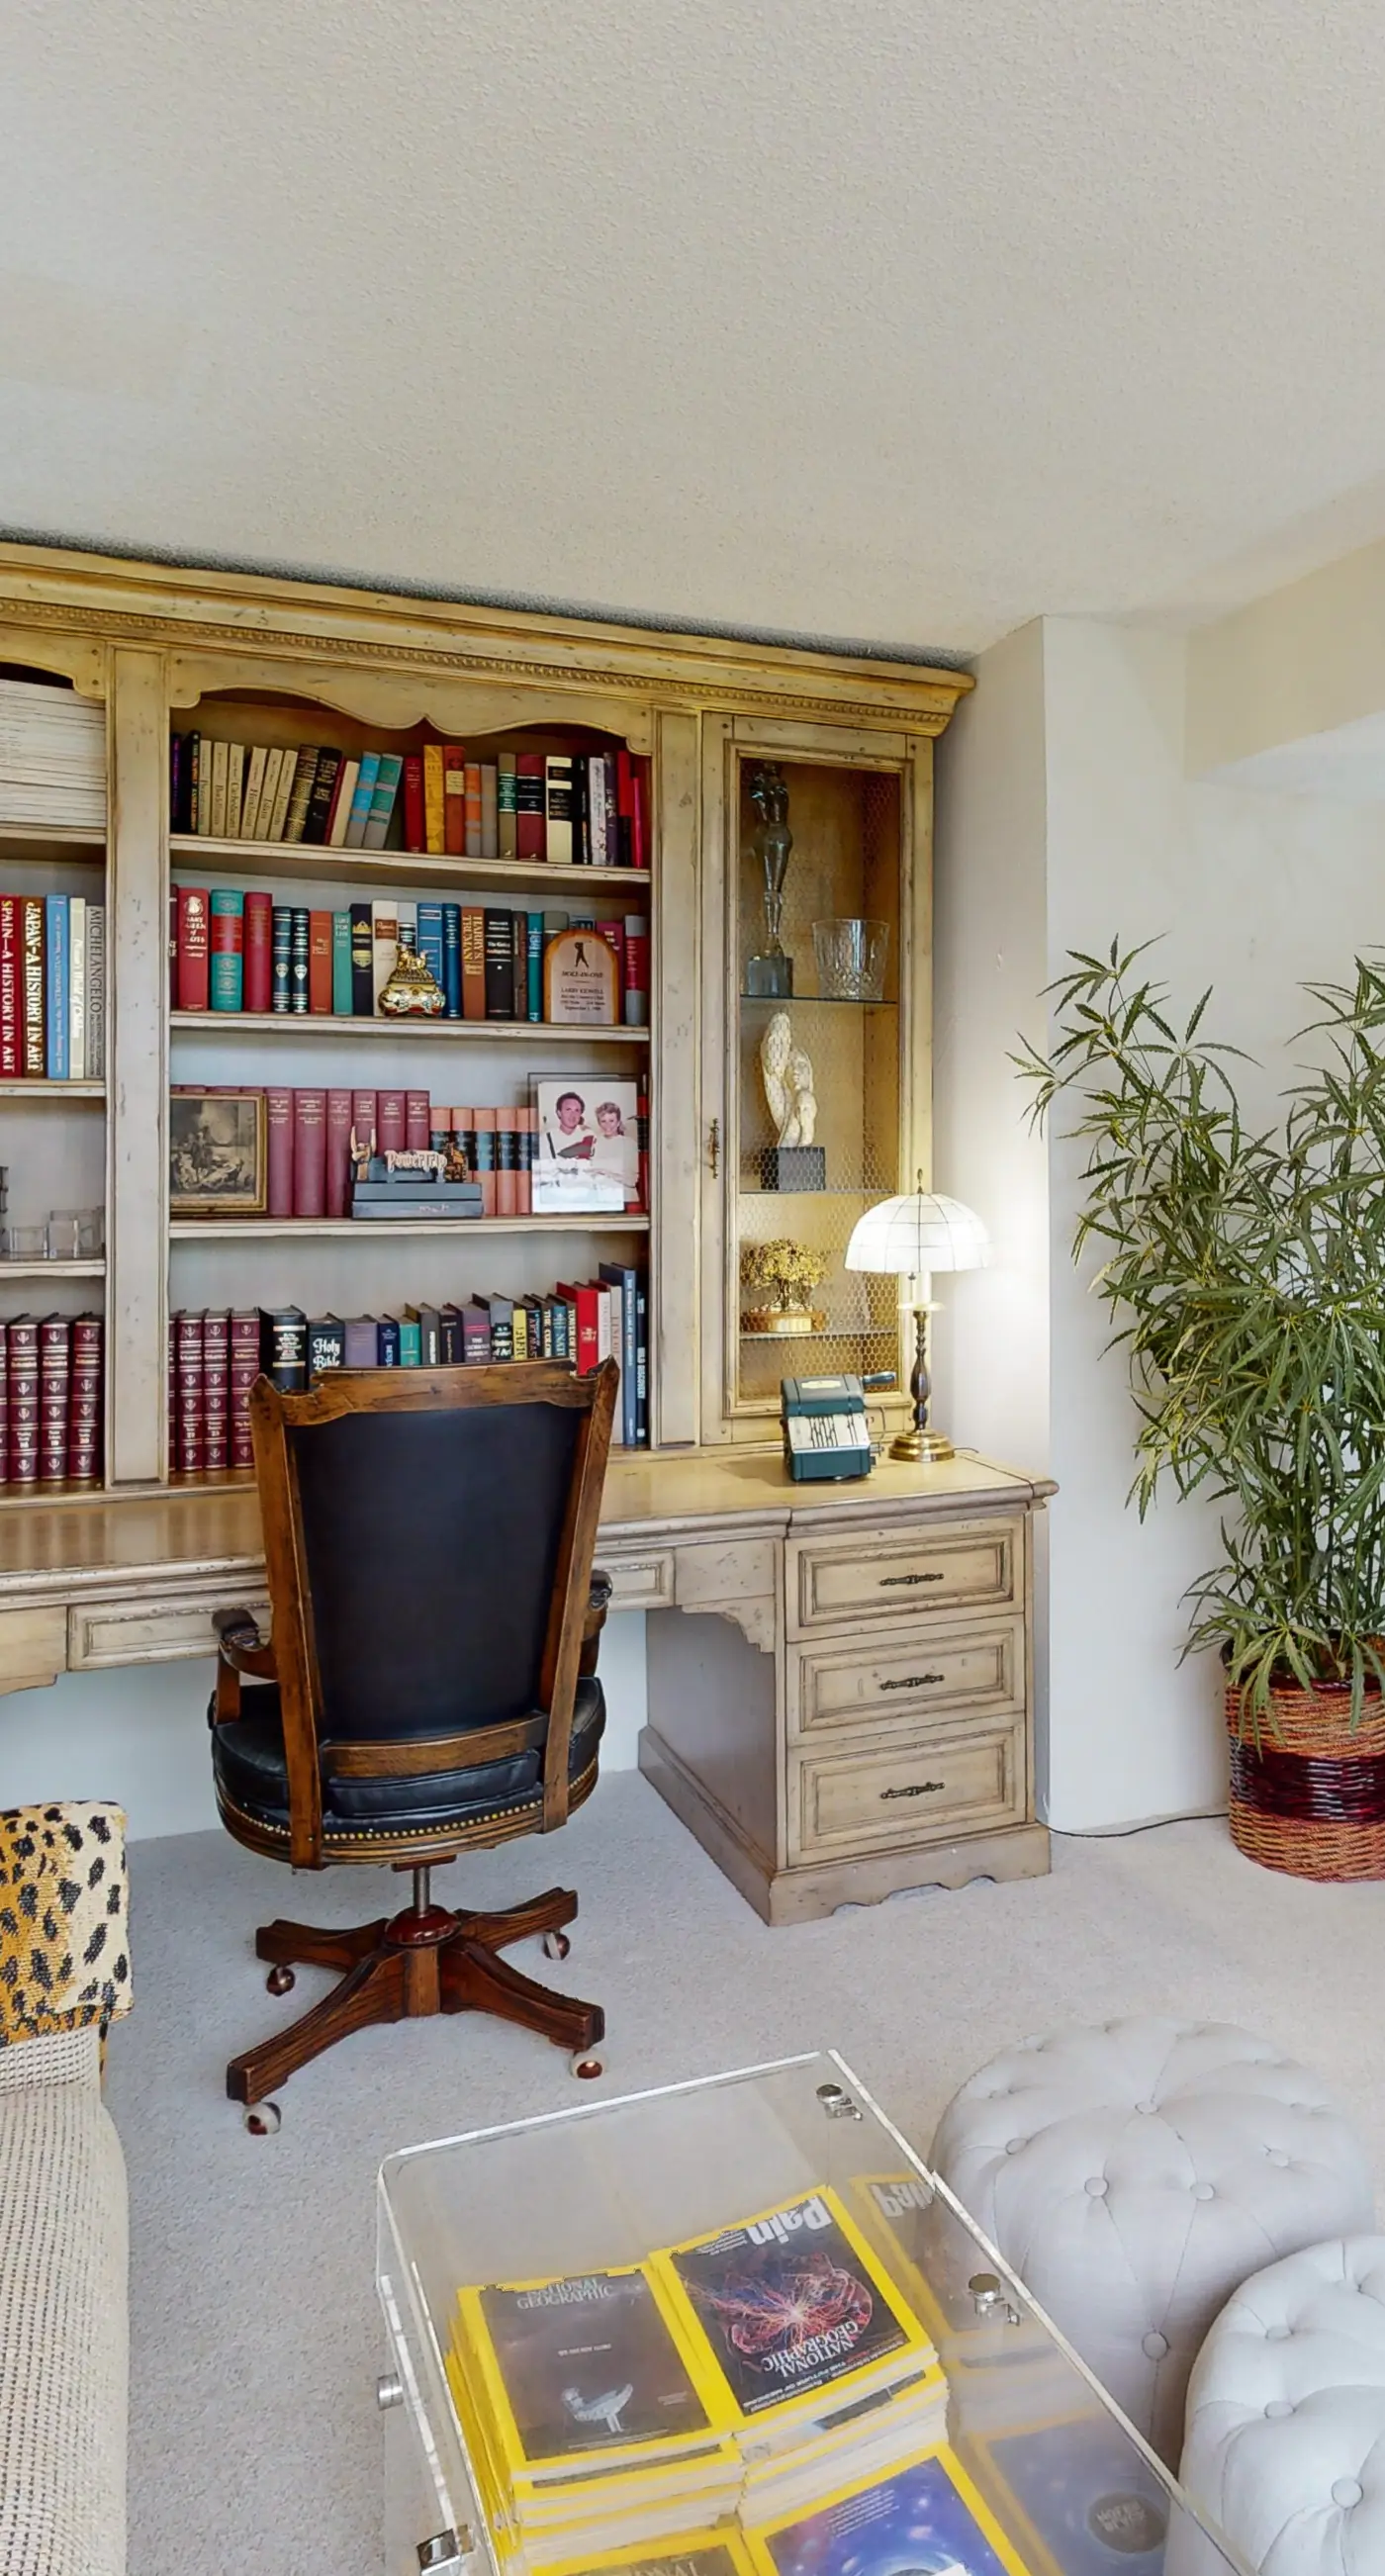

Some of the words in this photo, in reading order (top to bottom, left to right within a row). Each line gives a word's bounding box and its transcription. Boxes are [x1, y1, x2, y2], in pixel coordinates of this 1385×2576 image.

[462, 915, 473, 961] TRUMAN
[473, 916, 484, 952] HARRY
[90, 908, 103, 1013] MICHELANGELO
[2, 963, 15, 1023] HISTORY
[26, 966, 43, 1024] HISTORY
[2, 1026, 15, 1043] IN
[27, 1027, 44, 1043] IN
[3, 1046, 16, 1072] ART
[28, 1044, 44, 1071] ART
[313, 1337, 341, 1355] Holy
[568, 1336, 576, 1346] OF
[313, 1354, 340, 1370] Bible
[745, 2194, 833, 2247] Pain
[516, 2283, 614, 2310] GEOGRAPHIC
[762, 2320, 860, 2373] GEOGRAPHIC
[780, 2337, 856, 2378] NATIONAL
